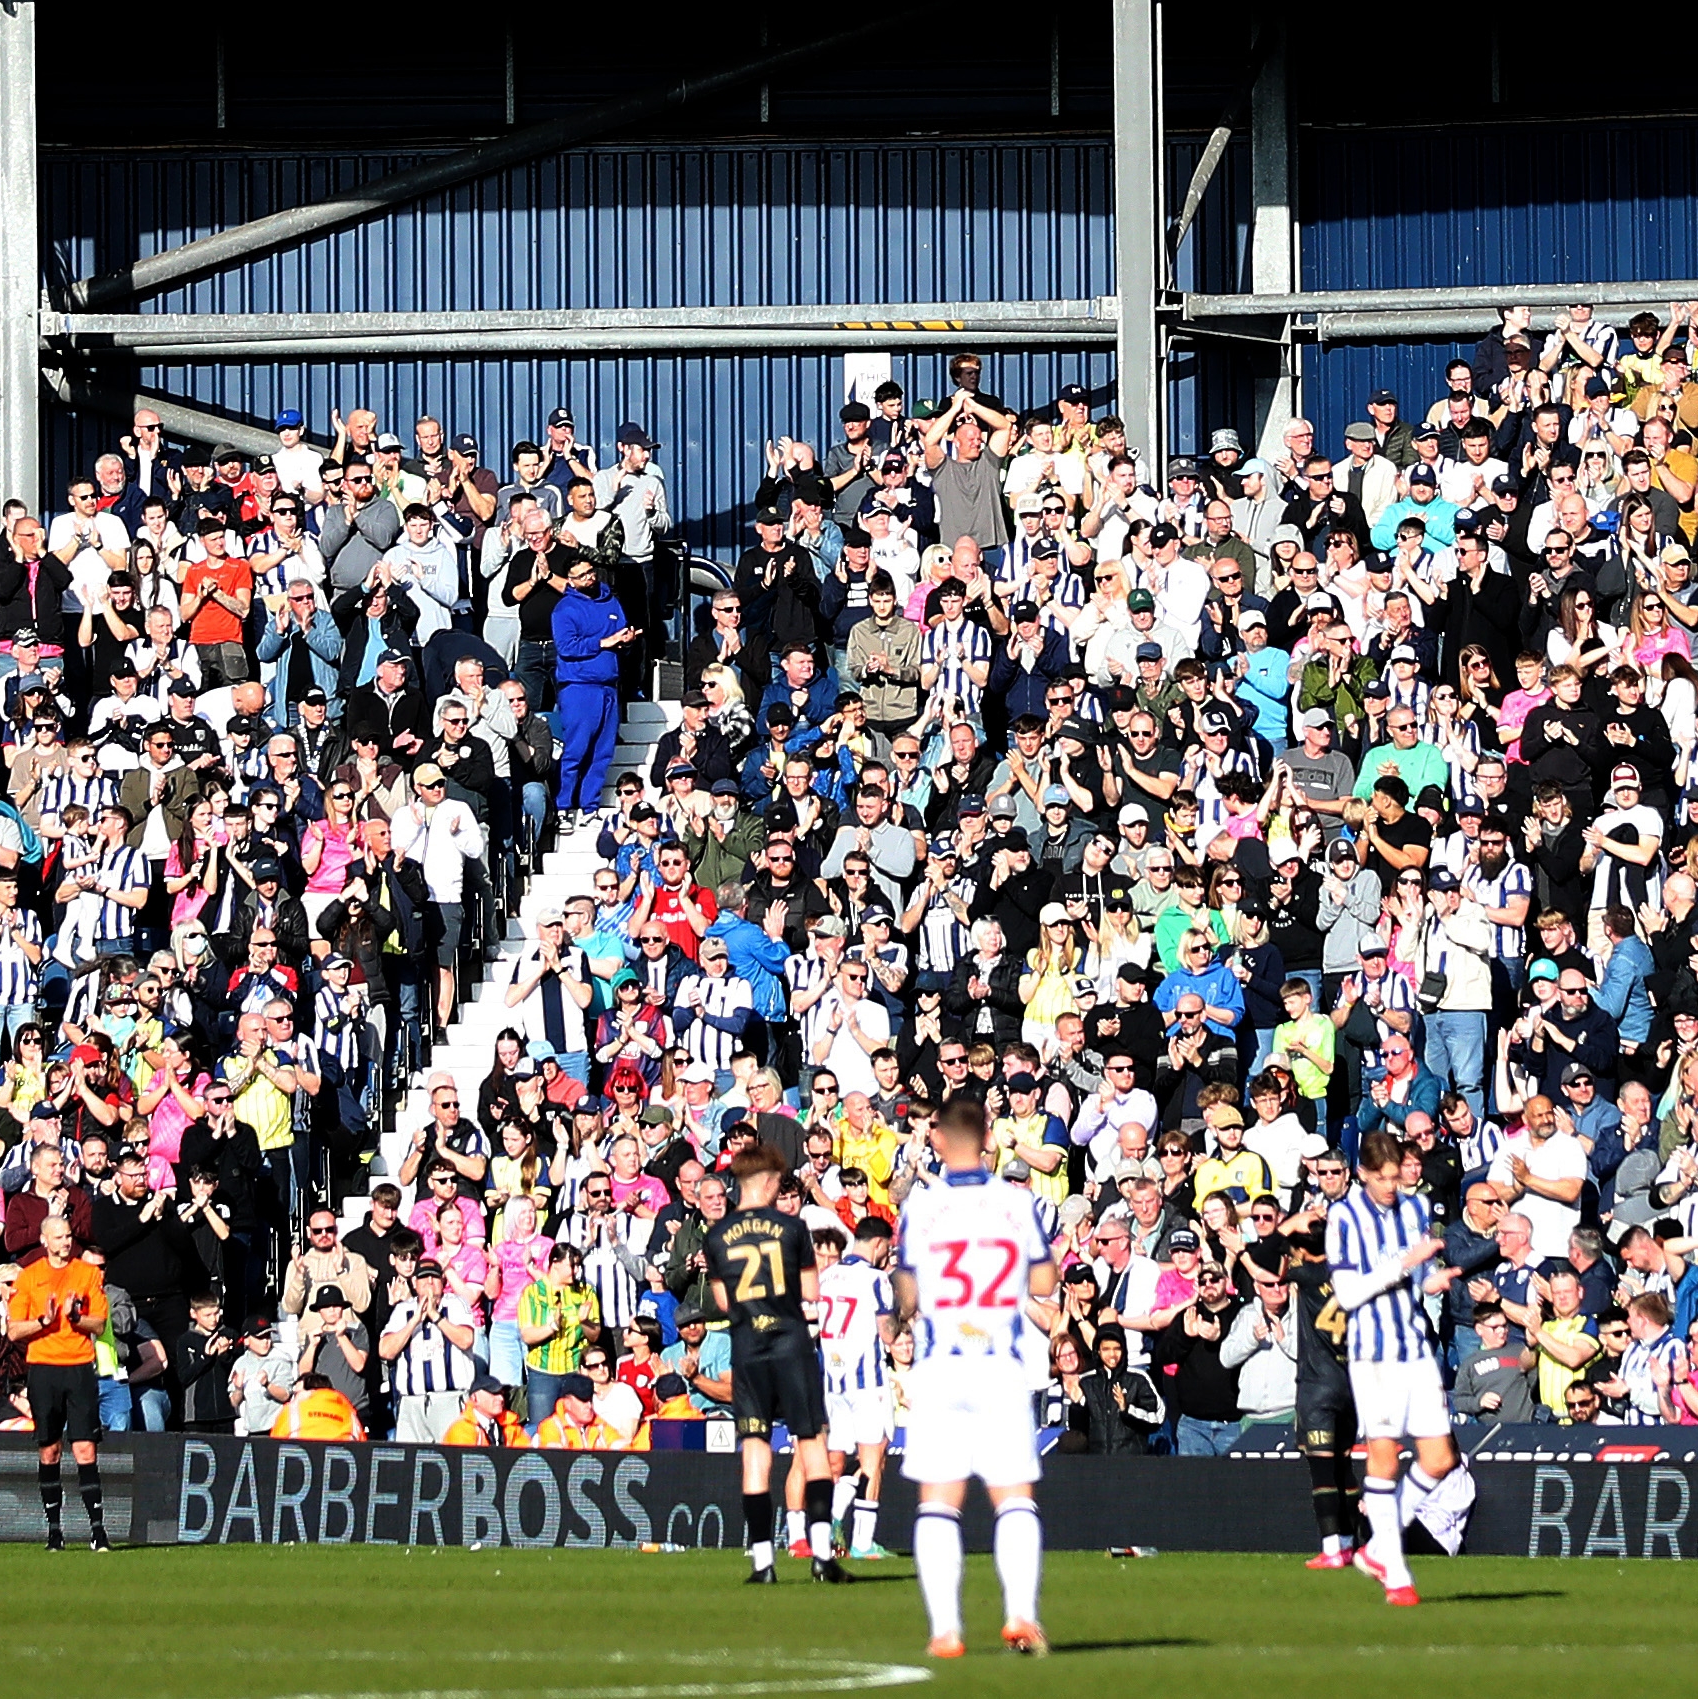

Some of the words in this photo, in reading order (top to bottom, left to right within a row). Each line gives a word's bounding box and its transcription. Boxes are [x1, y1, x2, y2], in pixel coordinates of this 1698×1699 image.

[721, 1218, 784, 1245] MORGAN
[726, 1239, 787, 1303] 21
[929, 1239, 1020, 1310] 32
[818, 1295, 858, 1340] 27
